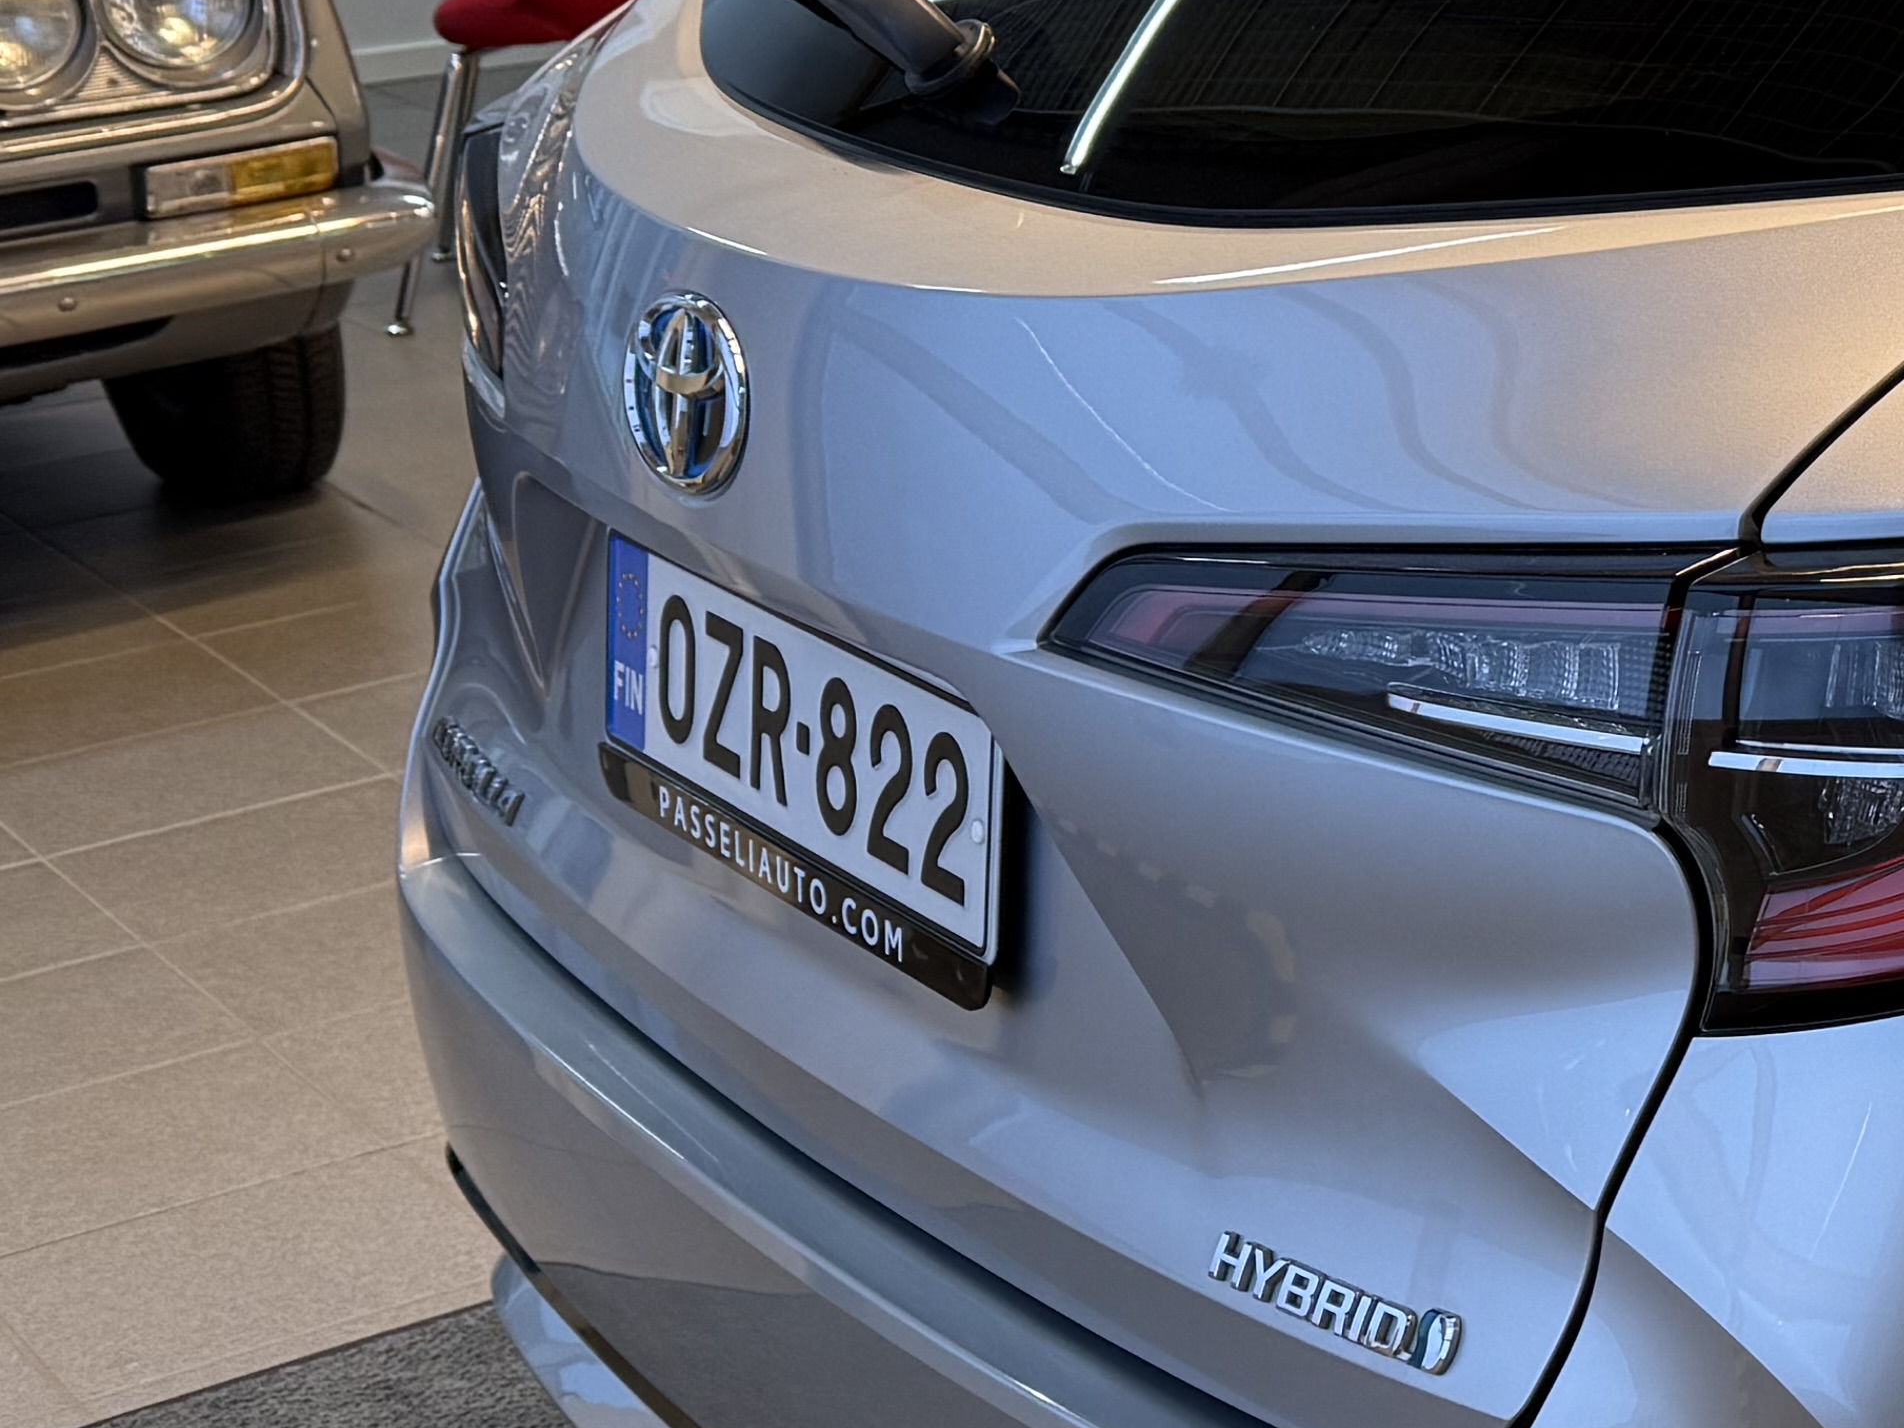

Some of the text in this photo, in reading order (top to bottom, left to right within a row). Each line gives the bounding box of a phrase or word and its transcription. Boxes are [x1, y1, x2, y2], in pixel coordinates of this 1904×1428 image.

[613, 658, 645, 716] FIN
[658, 593, 970, 908] OZR-822
[658, 785, 904, 964] PASSELIAUTO.COM
[1207, 1230, 1417, 1359] HYBRID
